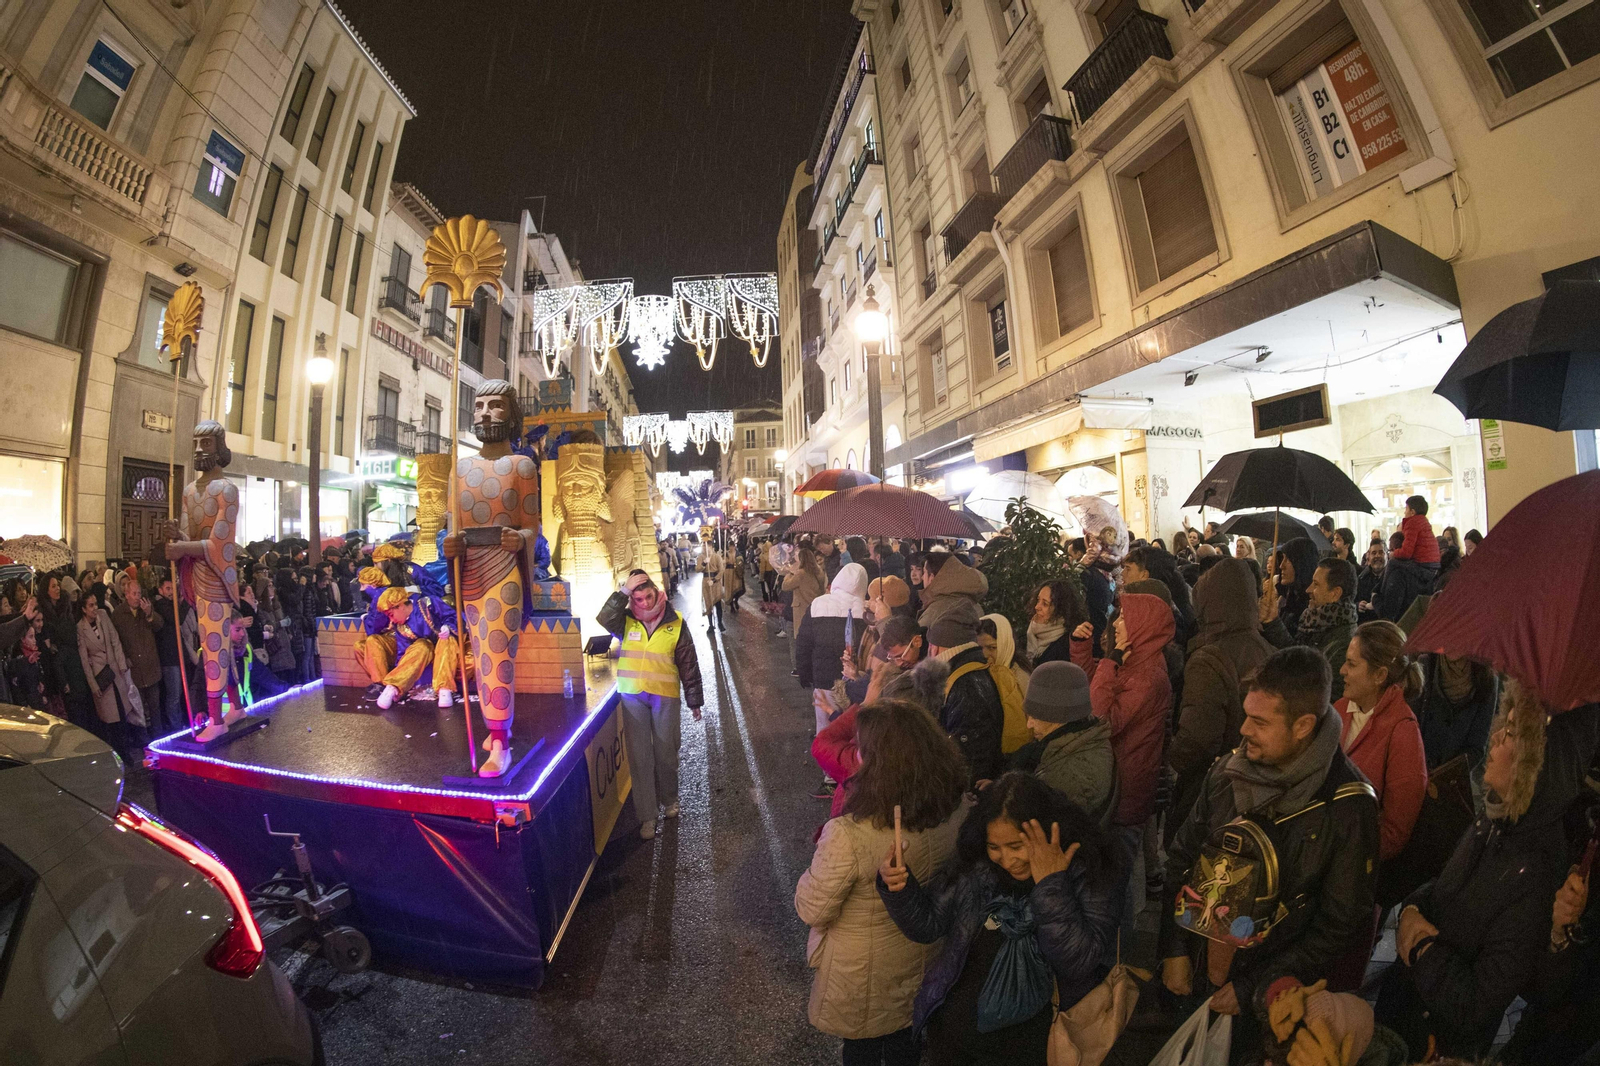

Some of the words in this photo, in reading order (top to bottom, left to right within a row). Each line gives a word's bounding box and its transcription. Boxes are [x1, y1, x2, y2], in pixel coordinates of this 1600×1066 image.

[100, 57, 125, 80] Sabadell
[1328, 46, 1362, 75] RESULTADOS
[1343, 61, 1369, 84] 48h.
[1312, 87, 1330, 110] B1
[1343, 99, 1357, 113] HAZ
[1355, 95, 1364, 106] TU
[1321, 112, 1340, 135] B2
[1349, 112, 1360, 124] DE
[1362, 120, 1373, 132] EN
[1370, 110, 1390, 127] CASA.
[1292, 112, 1323, 184] Linguaskill
[1333, 137, 1350, 160] C1
[1361, 142, 1378, 159] 958
[1375, 133, 1392, 151] 225
[1146, 426, 1202, 438] MAGOGA
